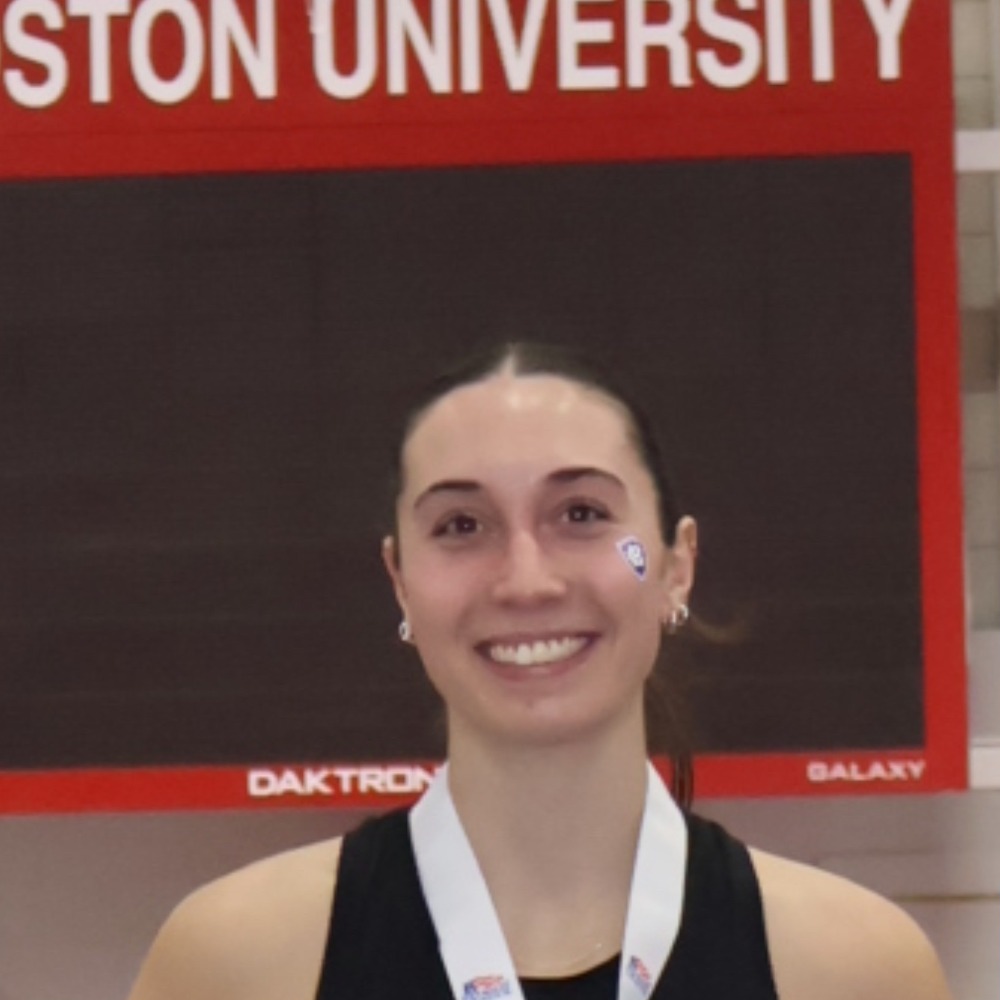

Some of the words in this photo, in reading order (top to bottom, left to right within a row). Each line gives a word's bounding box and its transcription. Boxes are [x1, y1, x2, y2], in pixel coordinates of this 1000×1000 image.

[3, 0, 278, 108] STON
[309, 0, 912, 98] UNIVERSITY
[807, 760, 926, 782] GALAXY
